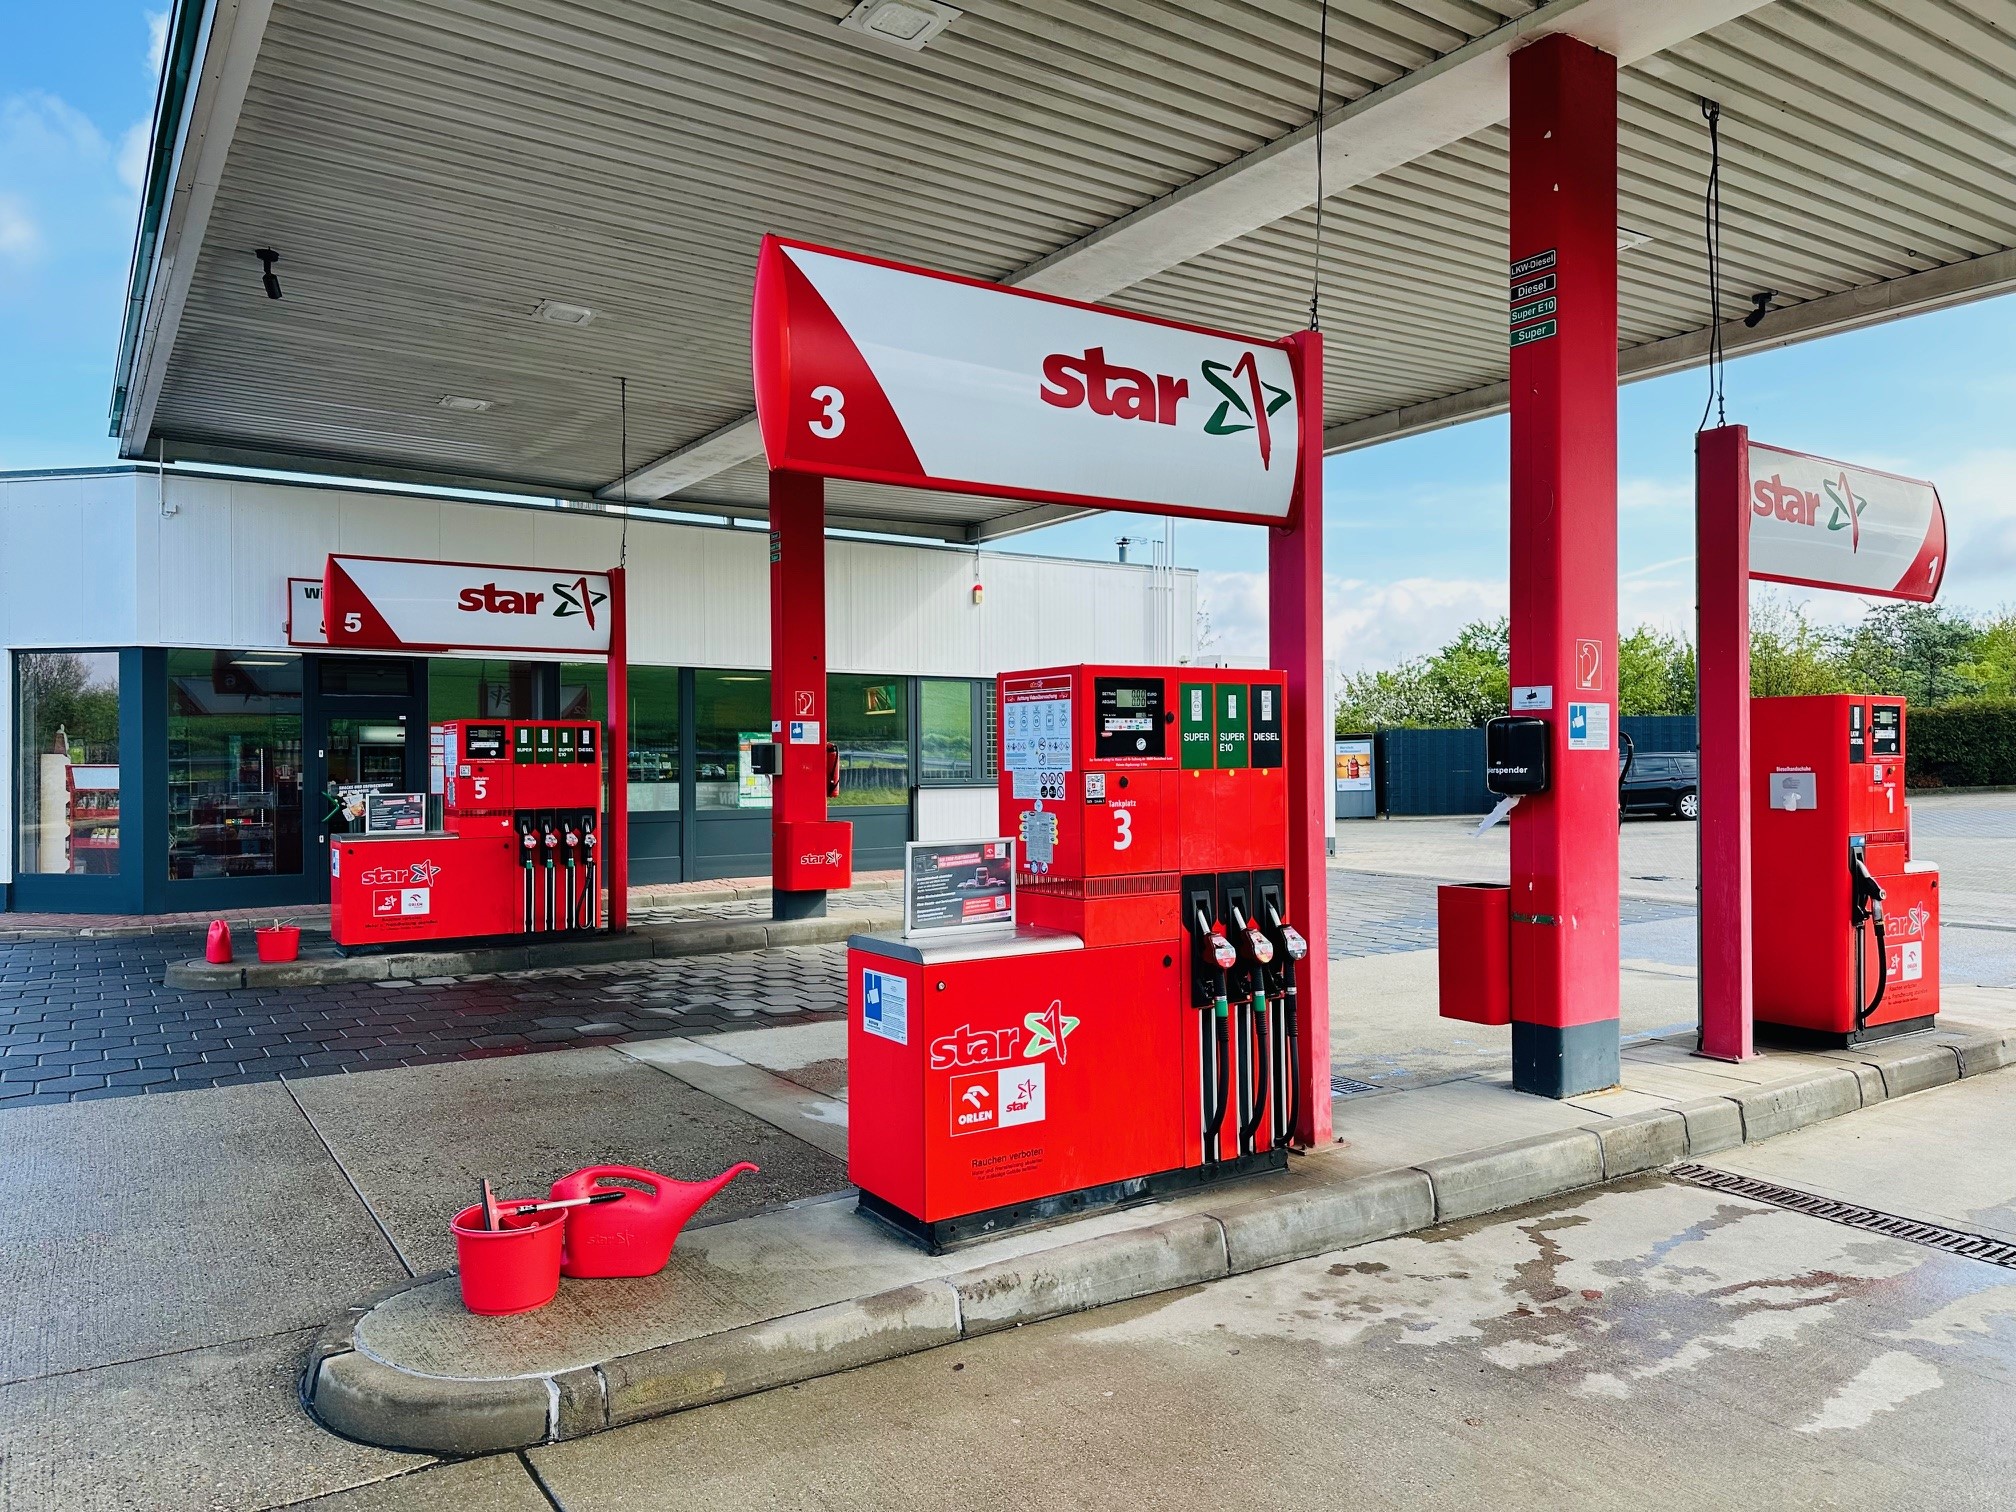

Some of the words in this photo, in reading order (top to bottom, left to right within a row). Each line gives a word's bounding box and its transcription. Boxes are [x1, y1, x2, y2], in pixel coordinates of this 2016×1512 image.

[1511, 254, 1554, 275] LKW-Diesel
[1518, 279, 1547, 297] Diesel
[1511, 307, 1536, 321] Super
[1538, 300, 1554, 313] E10
[1518, 326, 1547, 341] Super
[1040, 346, 1189, 426] star
[808, 386, 845, 439] 3
[1752, 474, 1821, 527] star
[1928, 556, 1939, 584] 1
[457, 582, 544, 615] star
[344, 612, 362, 633] 5
[1183, 732, 1210, 742] SUPER
[1220, 732, 1245, 741] SUPER
[1253, 732, 1280, 741] DIESEL
[1220, 743, 1233, 752] E10
[475, 781, 487, 799] 5
[1108, 799, 1137, 809] Tankplatz
[1886, 787, 1894, 814] 1
[1113, 809, 1133, 851] 3
[800, 852, 825, 865] star
[361, 866, 409, 885] star
[1884, 912, 1908, 938] tar
[930, 1023, 1020, 1070] star
[1006, 1100, 1028, 1113] star
[958, 1109, 993, 1125] ORLEN
[971, 1155, 1007, 1168] Rauchen
[1009, 1148, 1044, 1160] verboten
